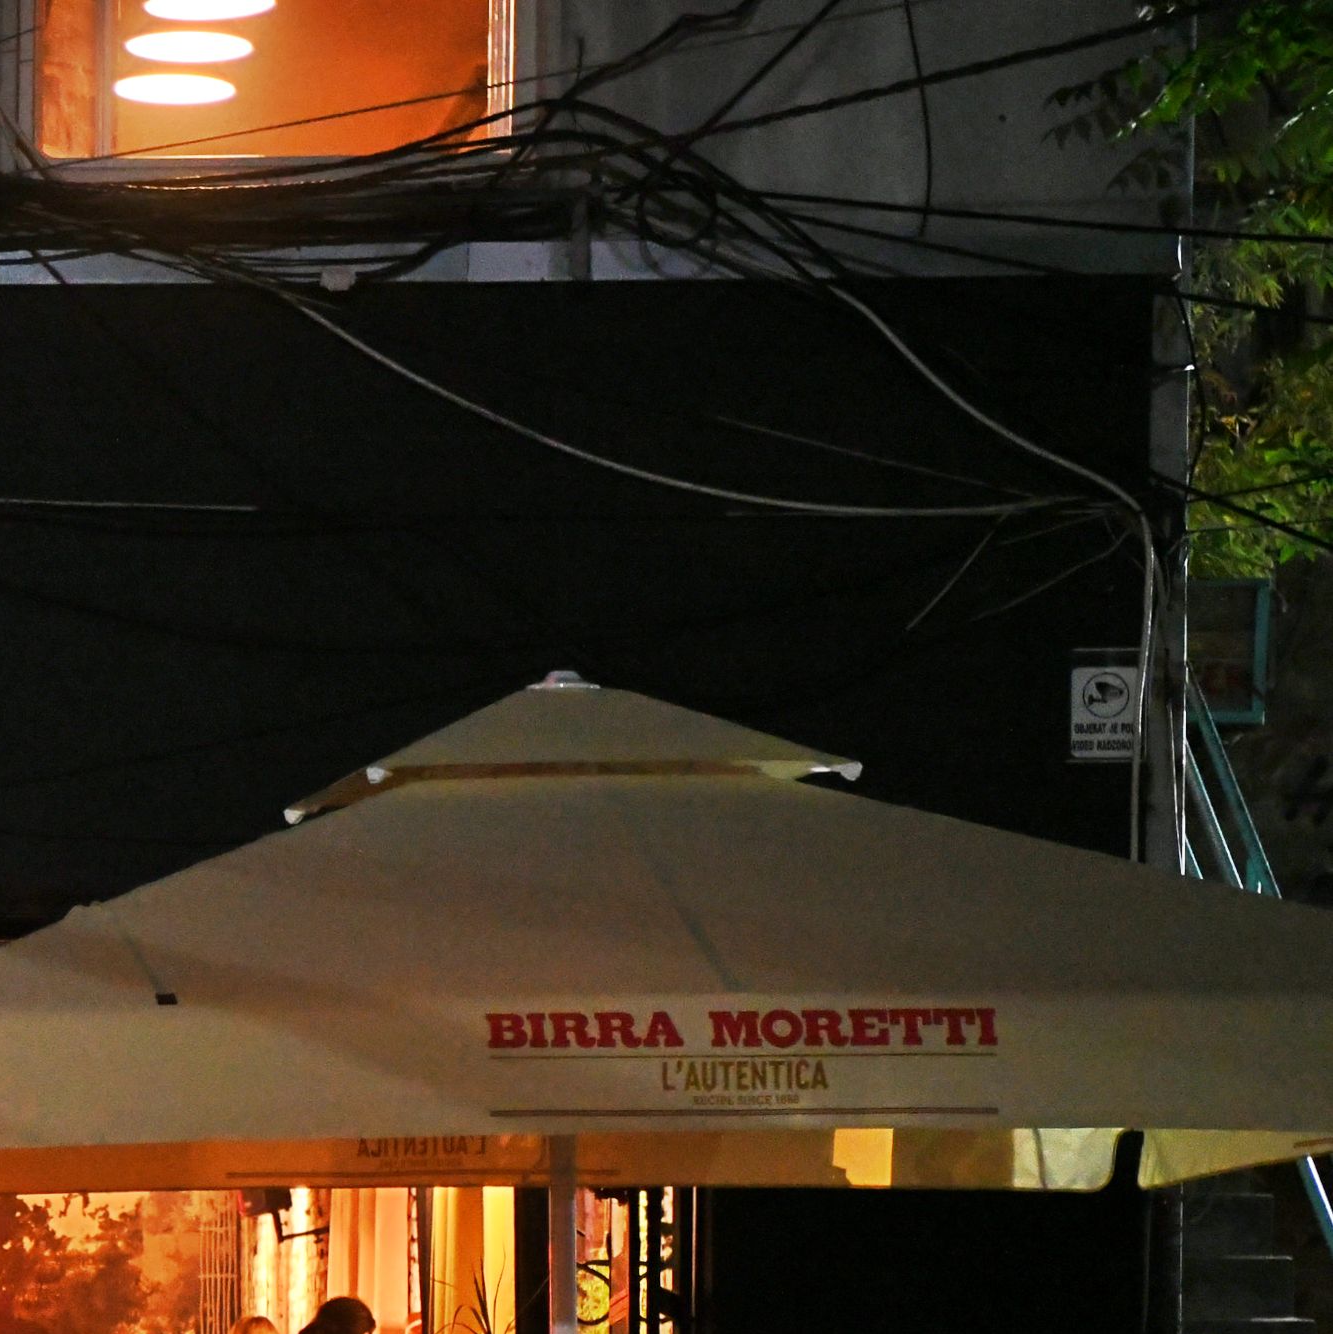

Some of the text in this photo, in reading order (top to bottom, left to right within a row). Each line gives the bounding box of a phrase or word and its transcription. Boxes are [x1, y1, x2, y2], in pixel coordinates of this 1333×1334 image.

[1097, 739, 1134, 751] NADZORO
[486, 1008, 998, 1049] BIRRA MORETTI
[661, 1058, 829, 1092] L'AUTENTICA
